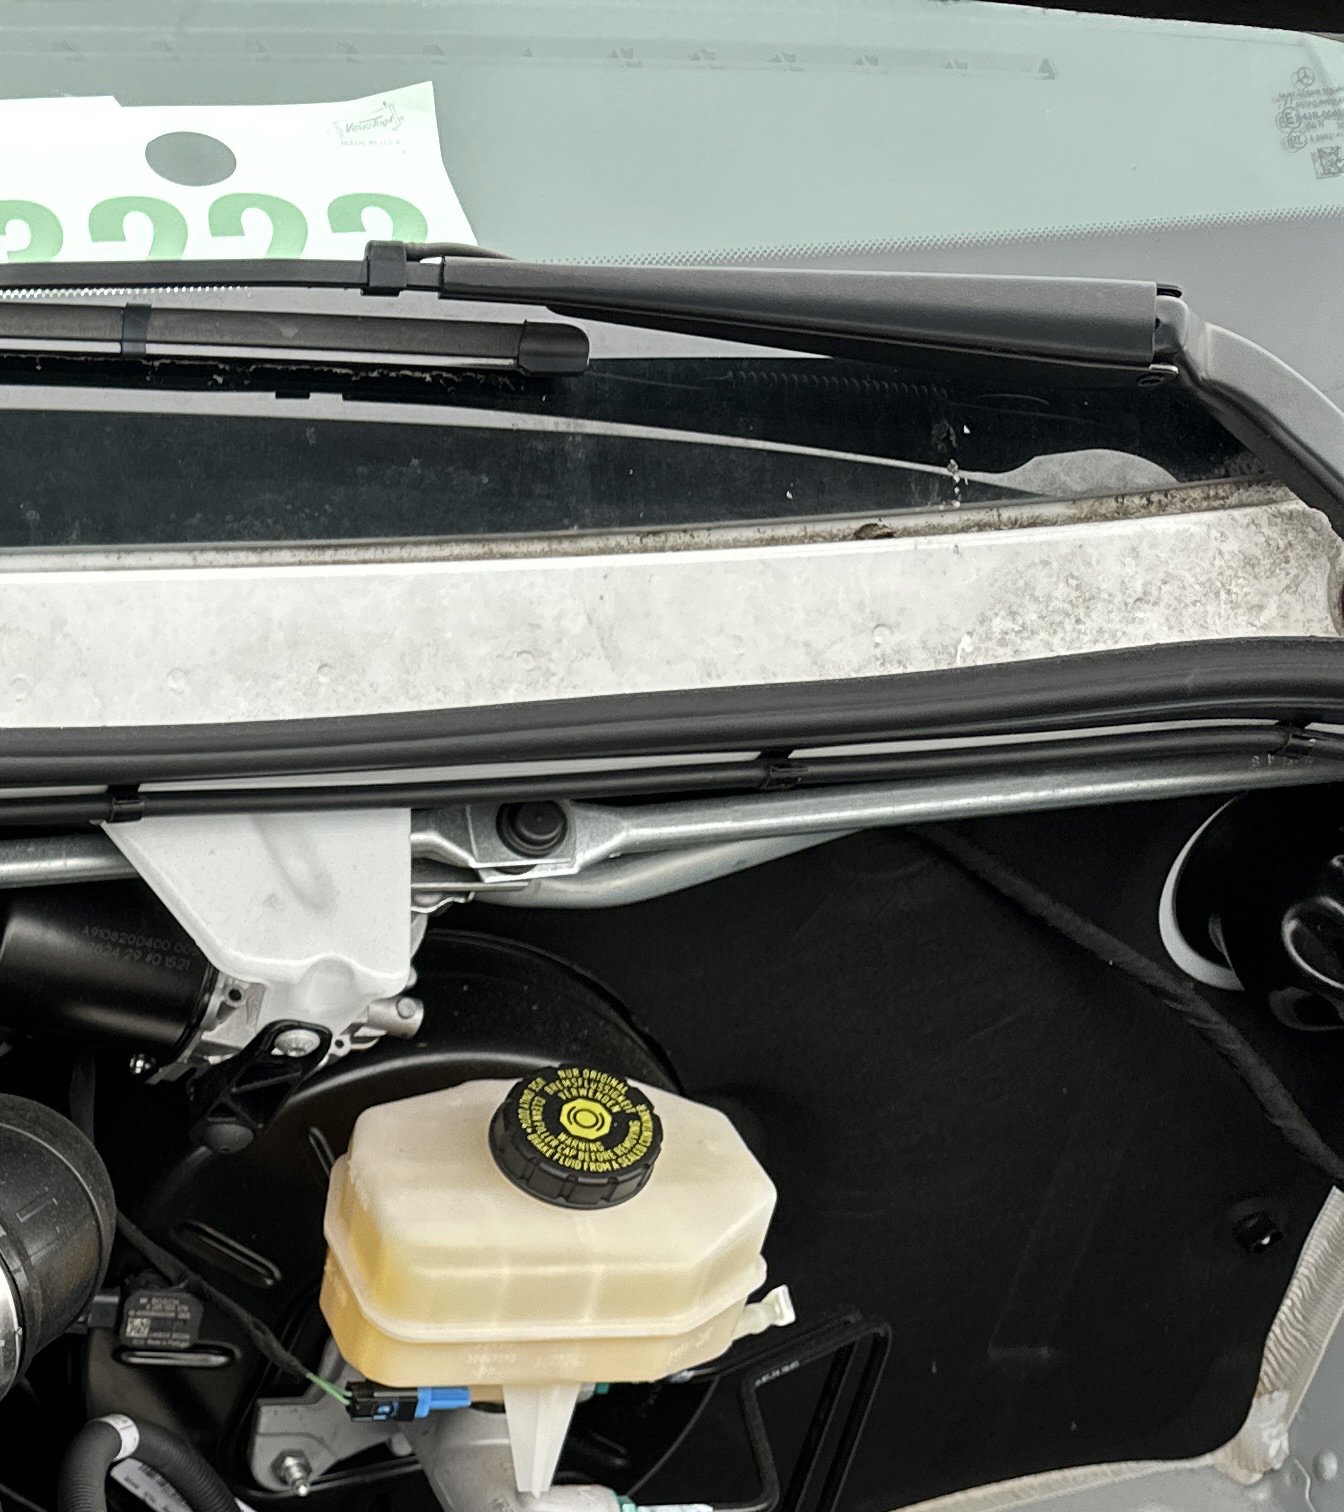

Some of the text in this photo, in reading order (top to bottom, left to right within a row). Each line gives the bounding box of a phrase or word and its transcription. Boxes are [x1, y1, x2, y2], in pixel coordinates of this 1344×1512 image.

[557, 1068, 629, 1094] NUR ORIGINAL
[556, 1142, 578, 1156] CAP
[552, 1151, 582, 1171] FLUID
